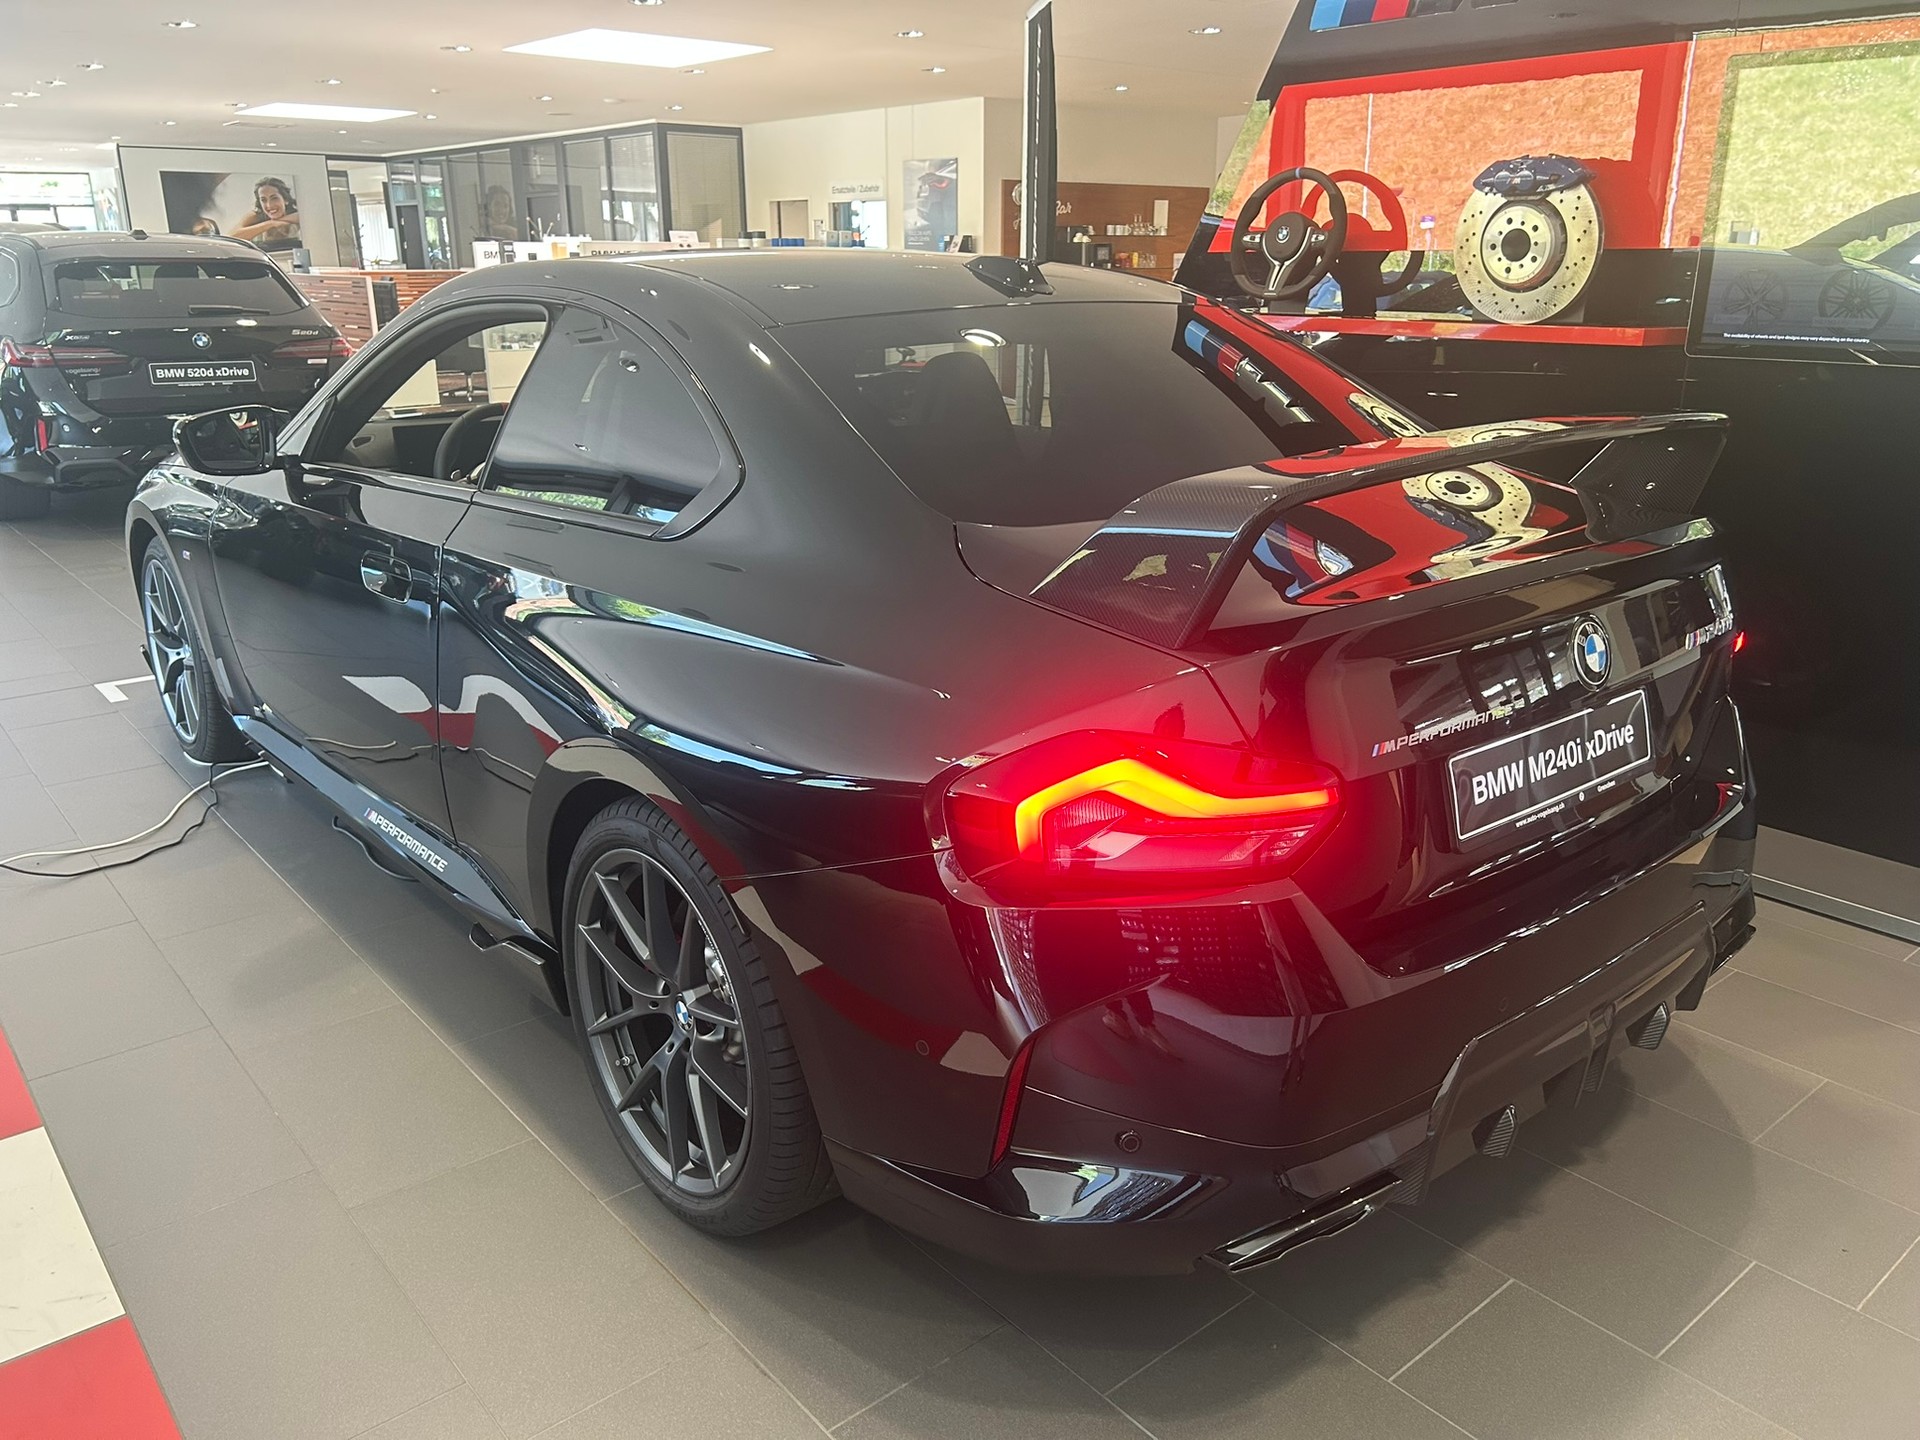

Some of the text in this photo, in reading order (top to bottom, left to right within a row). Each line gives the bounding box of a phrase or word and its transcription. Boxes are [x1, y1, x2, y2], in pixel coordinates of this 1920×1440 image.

[156, 366, 250, 378] BMW 520d xDrive
[1472, 722, 1636, 806] BMW M240i xDrive
